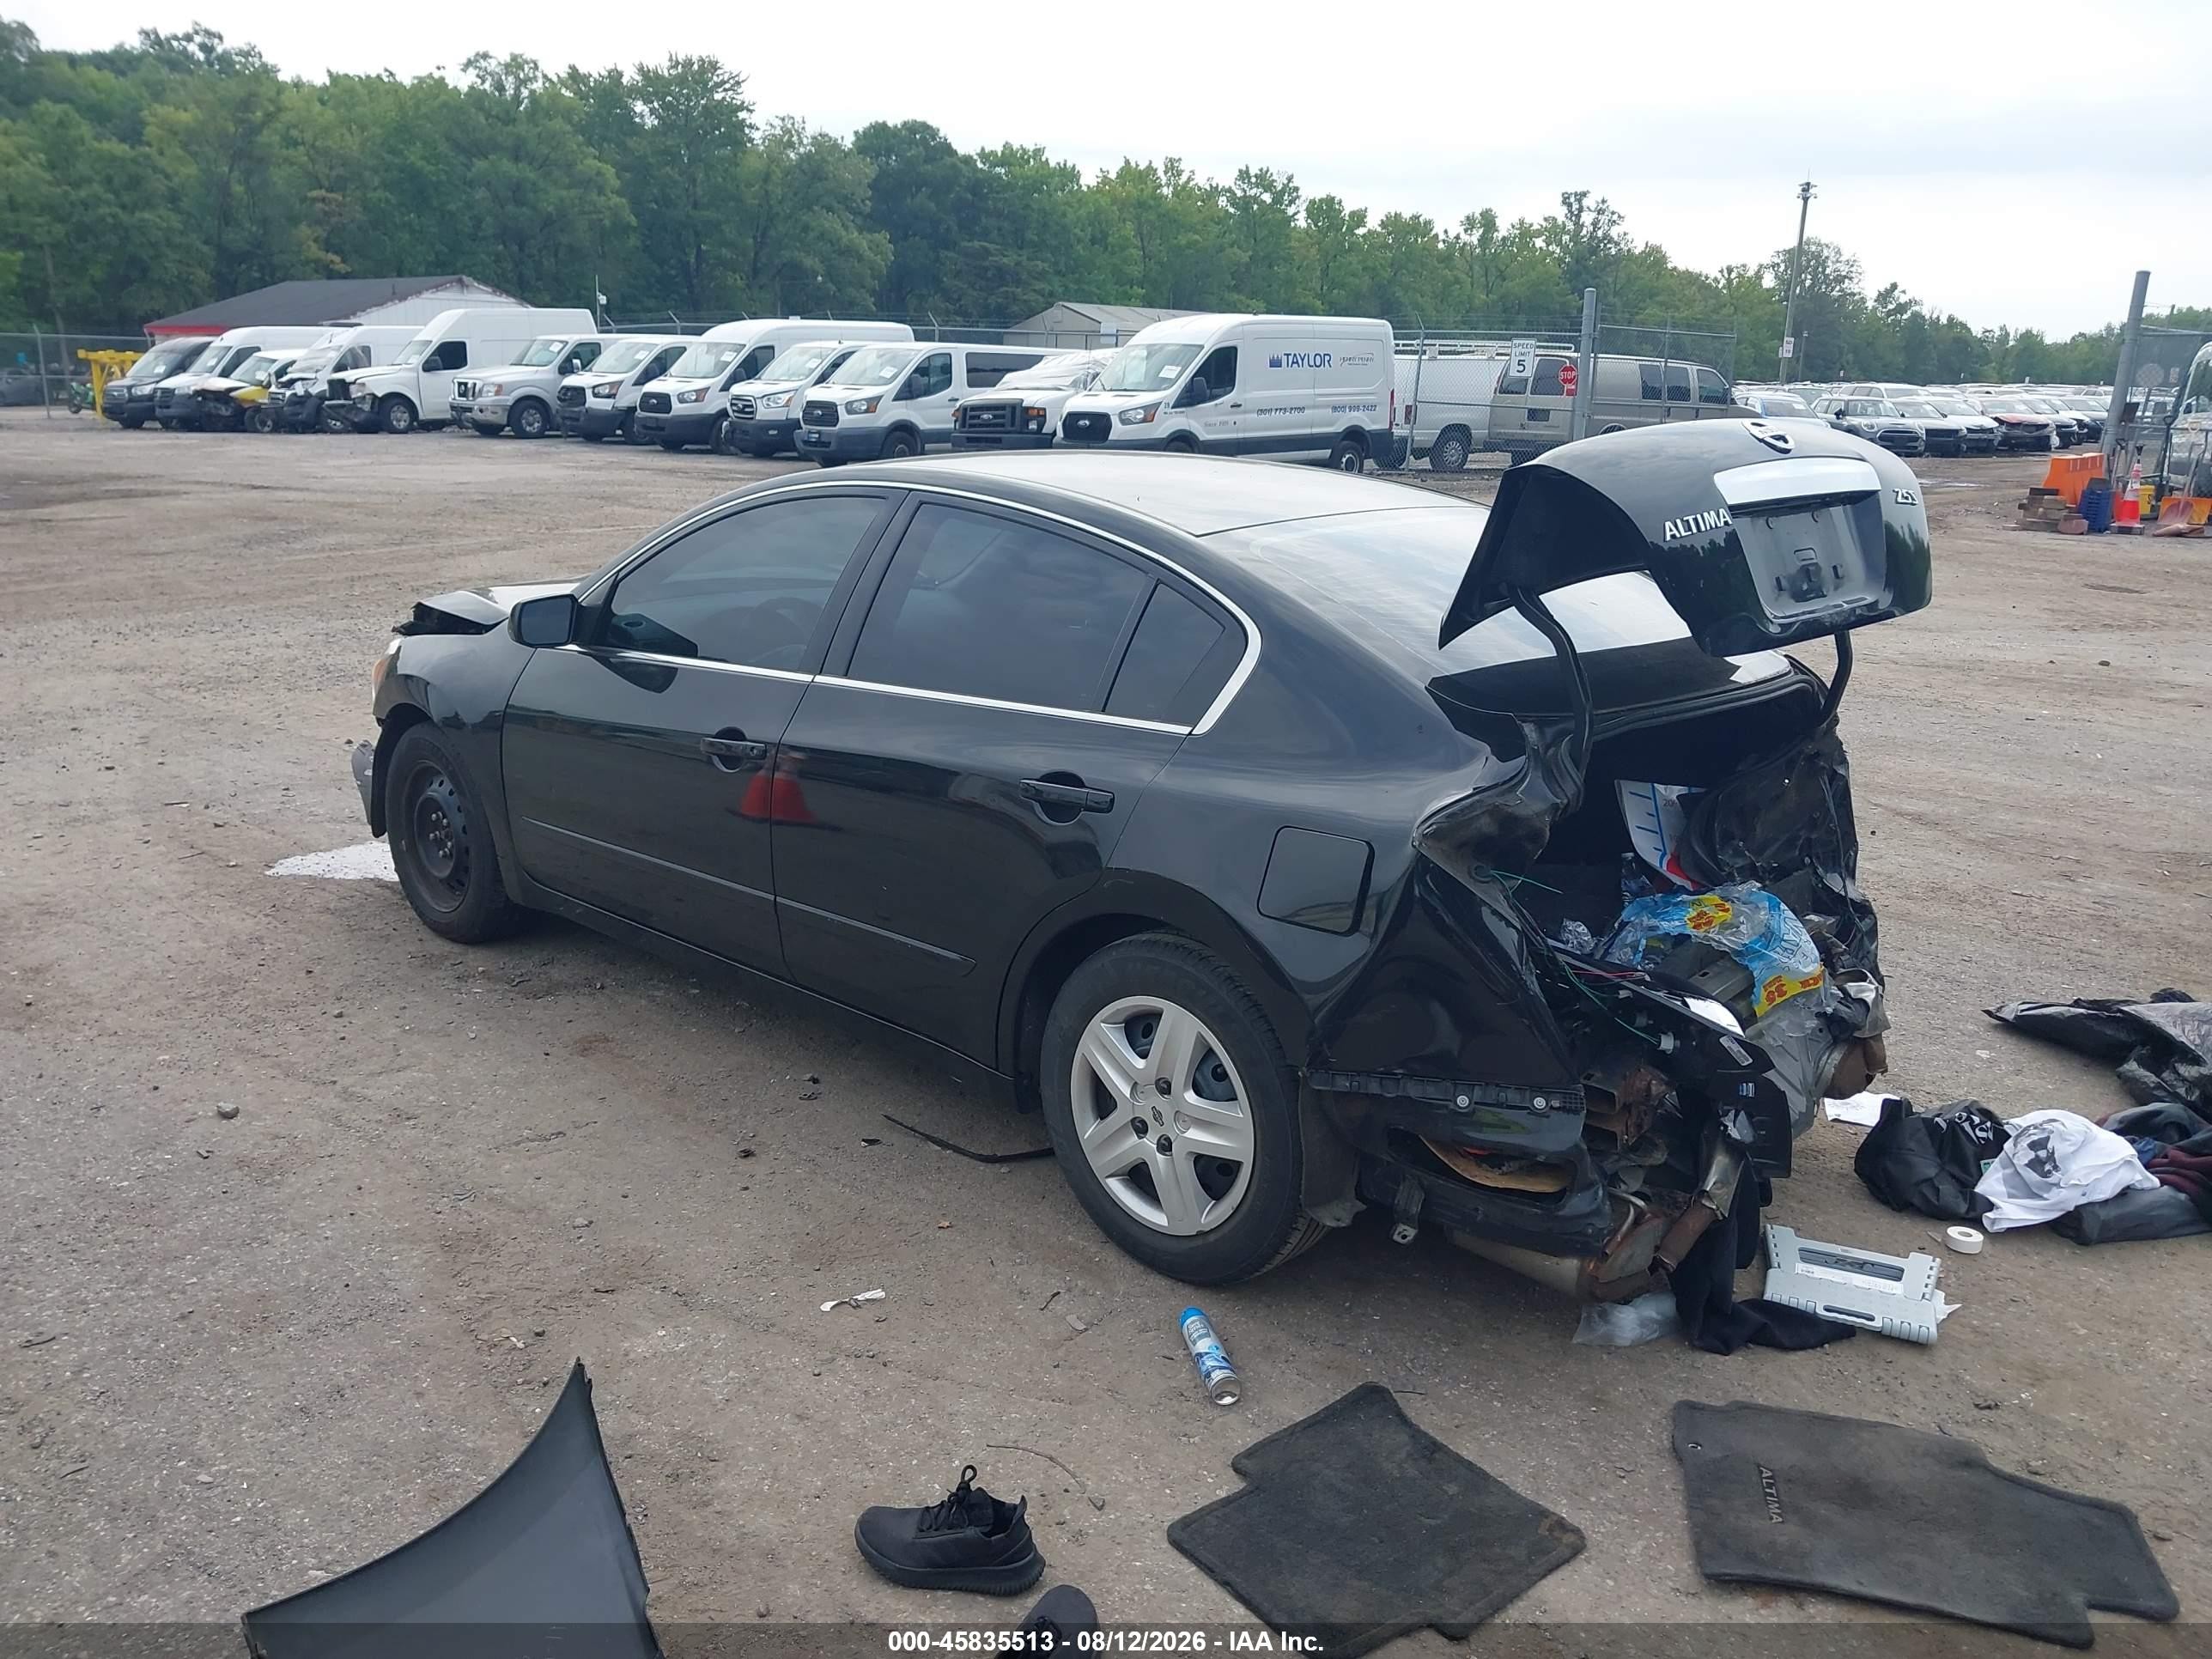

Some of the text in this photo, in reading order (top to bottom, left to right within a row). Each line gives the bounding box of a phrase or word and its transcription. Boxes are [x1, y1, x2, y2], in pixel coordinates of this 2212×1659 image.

[1283, 353, 1332, 368] TAYLOR
[1516, 359, 1526, 373] 5
[1256, 408, 1273, 417] (301)
[1664, 508, 1732, 541] ALTIMA
[1760, 1467, 1783, 1523] ALTIMA
